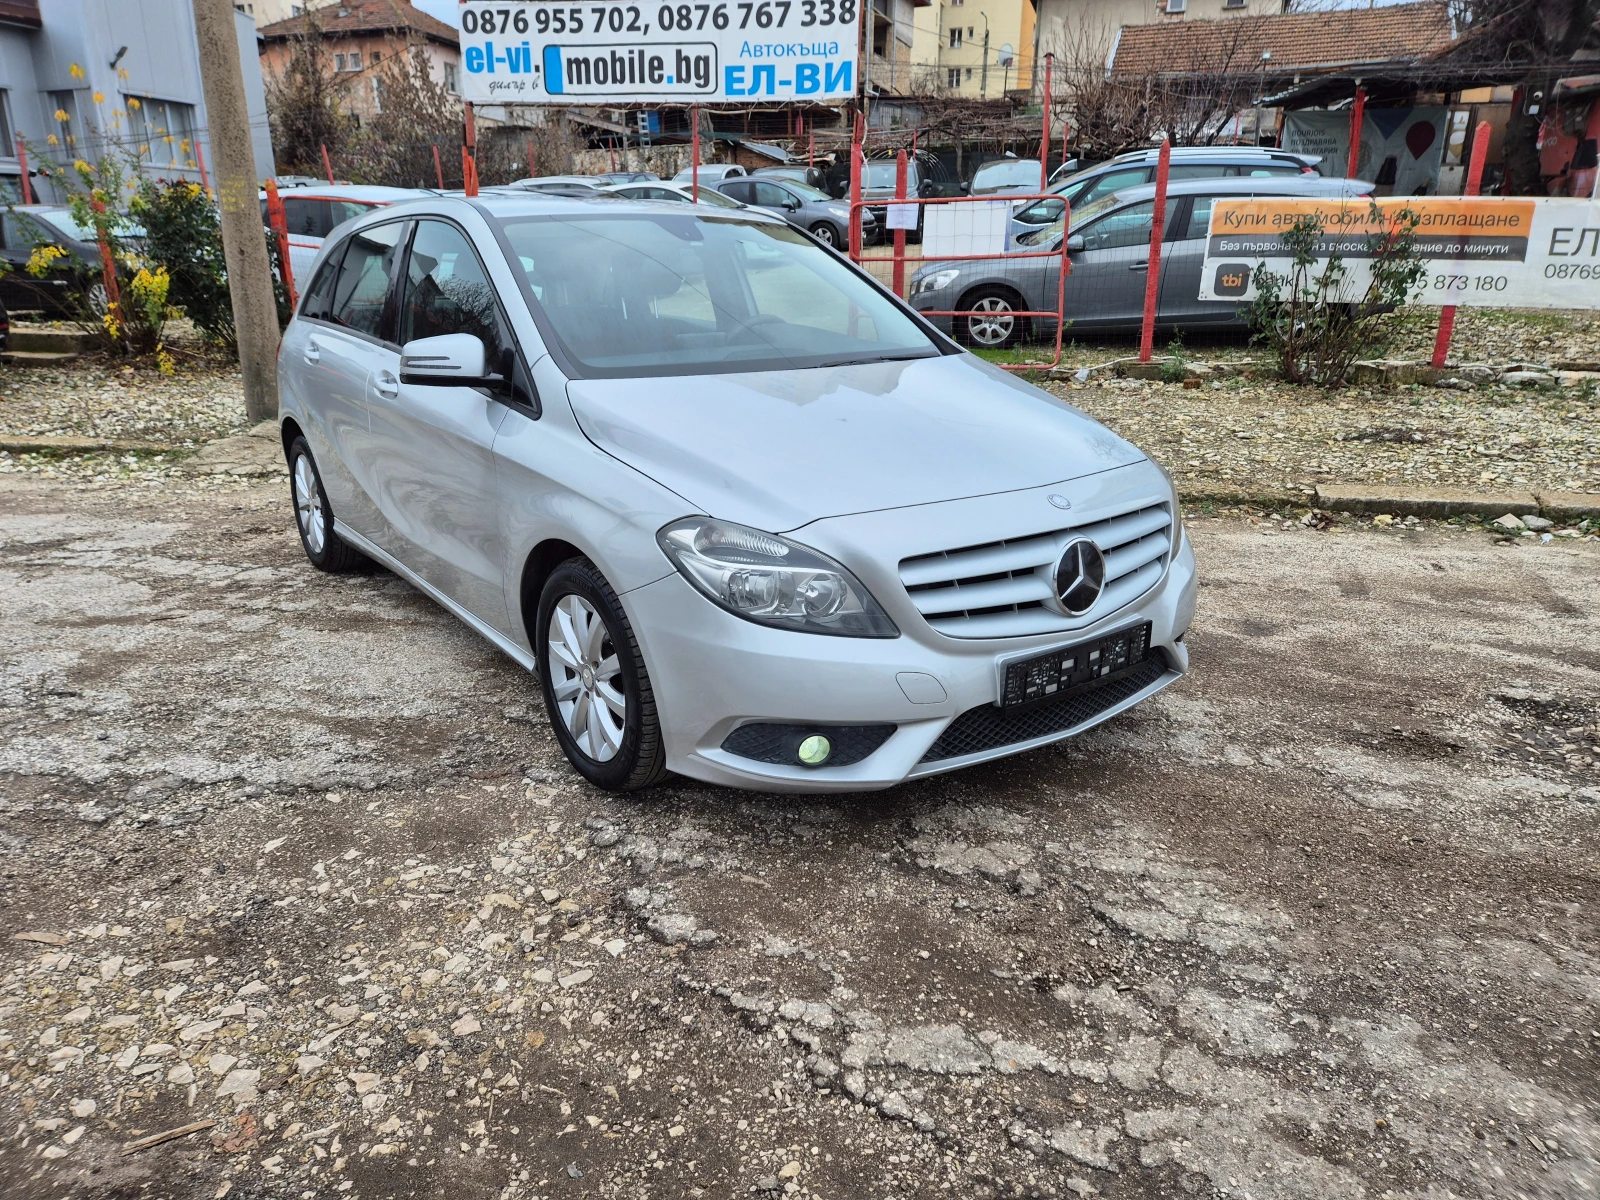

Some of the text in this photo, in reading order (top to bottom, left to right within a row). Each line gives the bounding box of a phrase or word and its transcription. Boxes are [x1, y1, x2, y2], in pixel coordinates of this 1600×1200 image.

[462, 0, 856, 36] 0876 955 702, 0876 767 338
[739, 40, 839, 59] Автокъща
[566, 48, 710, 88] mobile.bg
[488, 74, 541, 95] дилър в
[724, 60, 853, 96] ЕЛ-ВИ
[1290, 138, 1337, 146] ПОЗДРАВЯВА
[1291, 129, 1326, 137] BOURJOIS
[1302, 147, 1338, 155] БЪЛГАРИЯ
[1223, 210, 1267, 229] Купи
[1219, 241, 1240, 252] Без
[1444, 243, 1462, 254] до
[1463, 243, 1509, 256] минути
[1221, 273, 1243, 287] tbi
[1433, 274, 1469, 291] 873
[1474, 275, 1508, 292] 180
